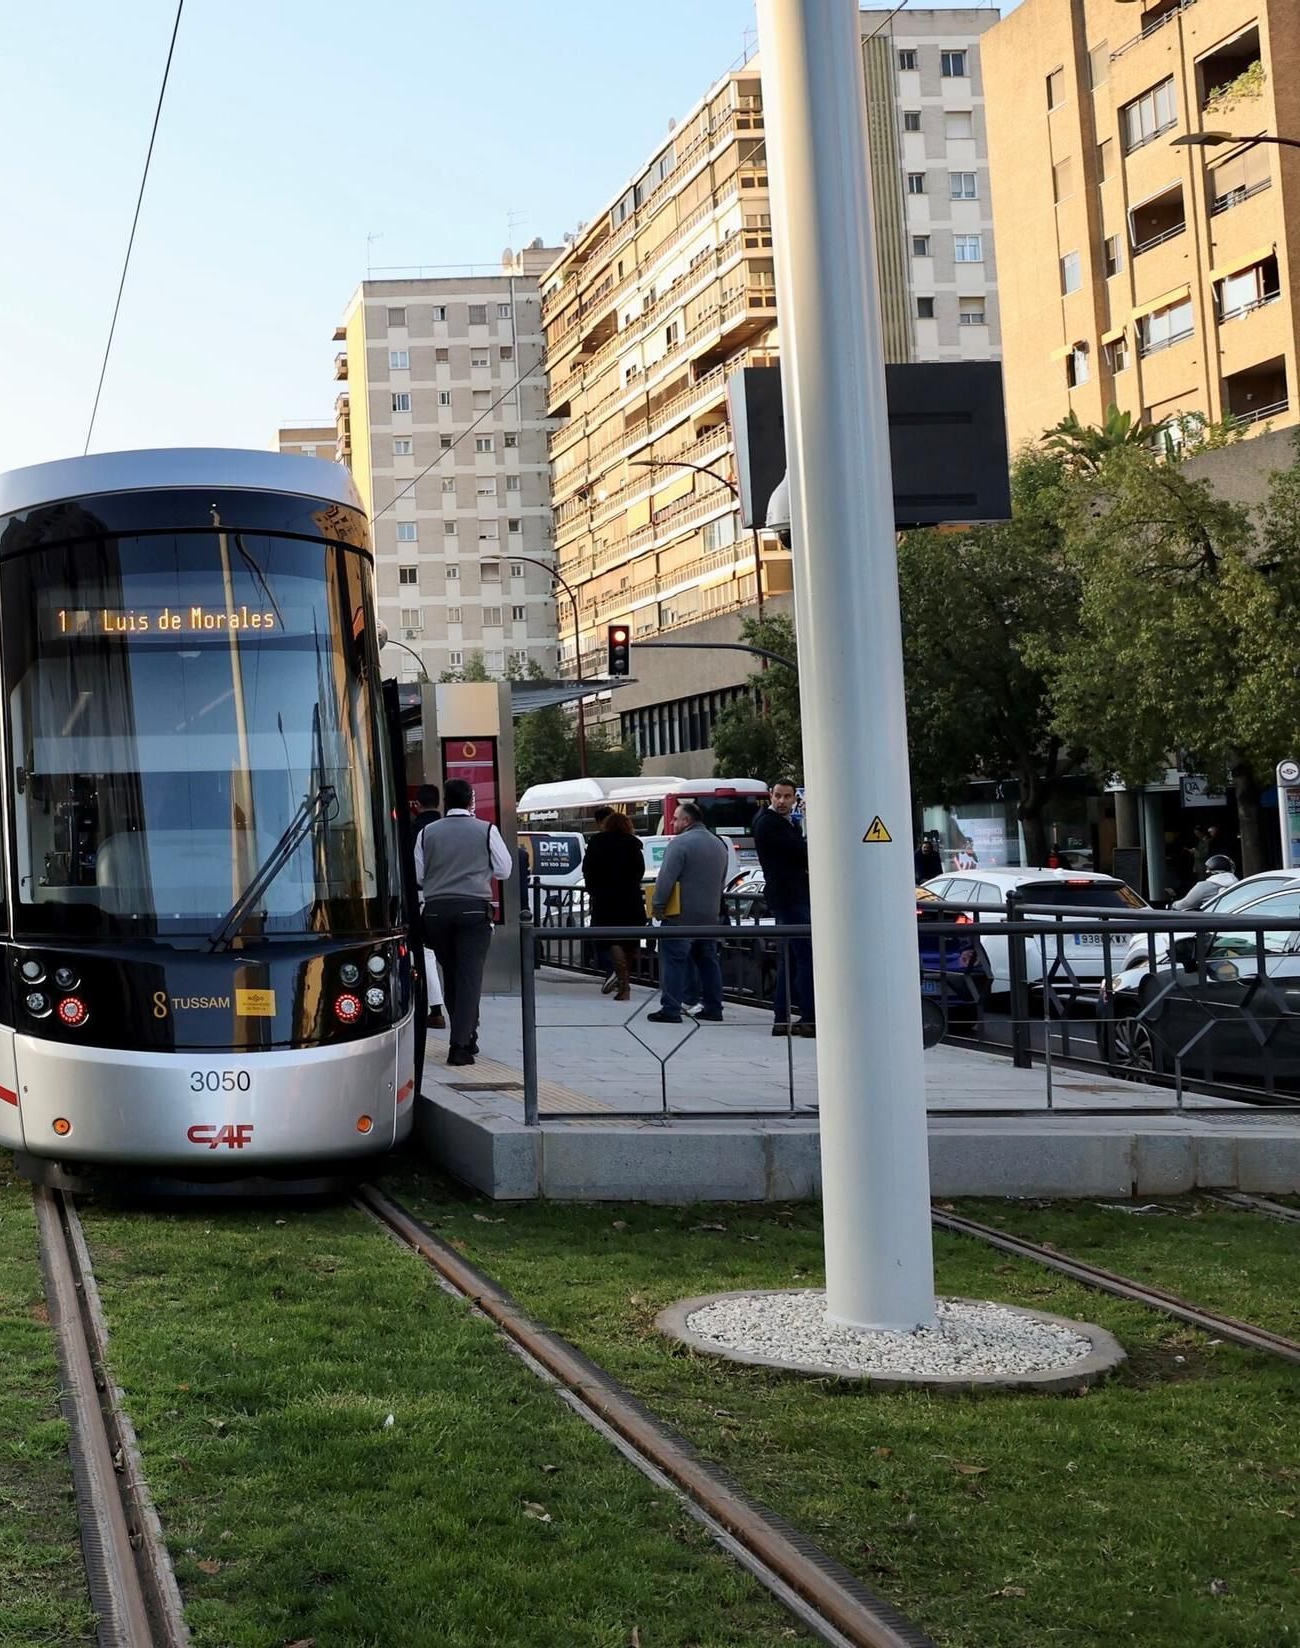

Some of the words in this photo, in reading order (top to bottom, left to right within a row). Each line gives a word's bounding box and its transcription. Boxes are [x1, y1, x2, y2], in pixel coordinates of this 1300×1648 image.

[58, 609, 67, 632] 1
[103, 609, 148, 631] Luis
[158, 607, 181, 630] de
[191, 606, 274, 630] Morales
[539, 841, 568, 852] DFM
[1082, 935, 1102, 944] 938
[171, 997, 230, 1009] TUSSAM
[190, 1070, 251, 1092] 3050
[187, 1124, 254, 1149] CAF
